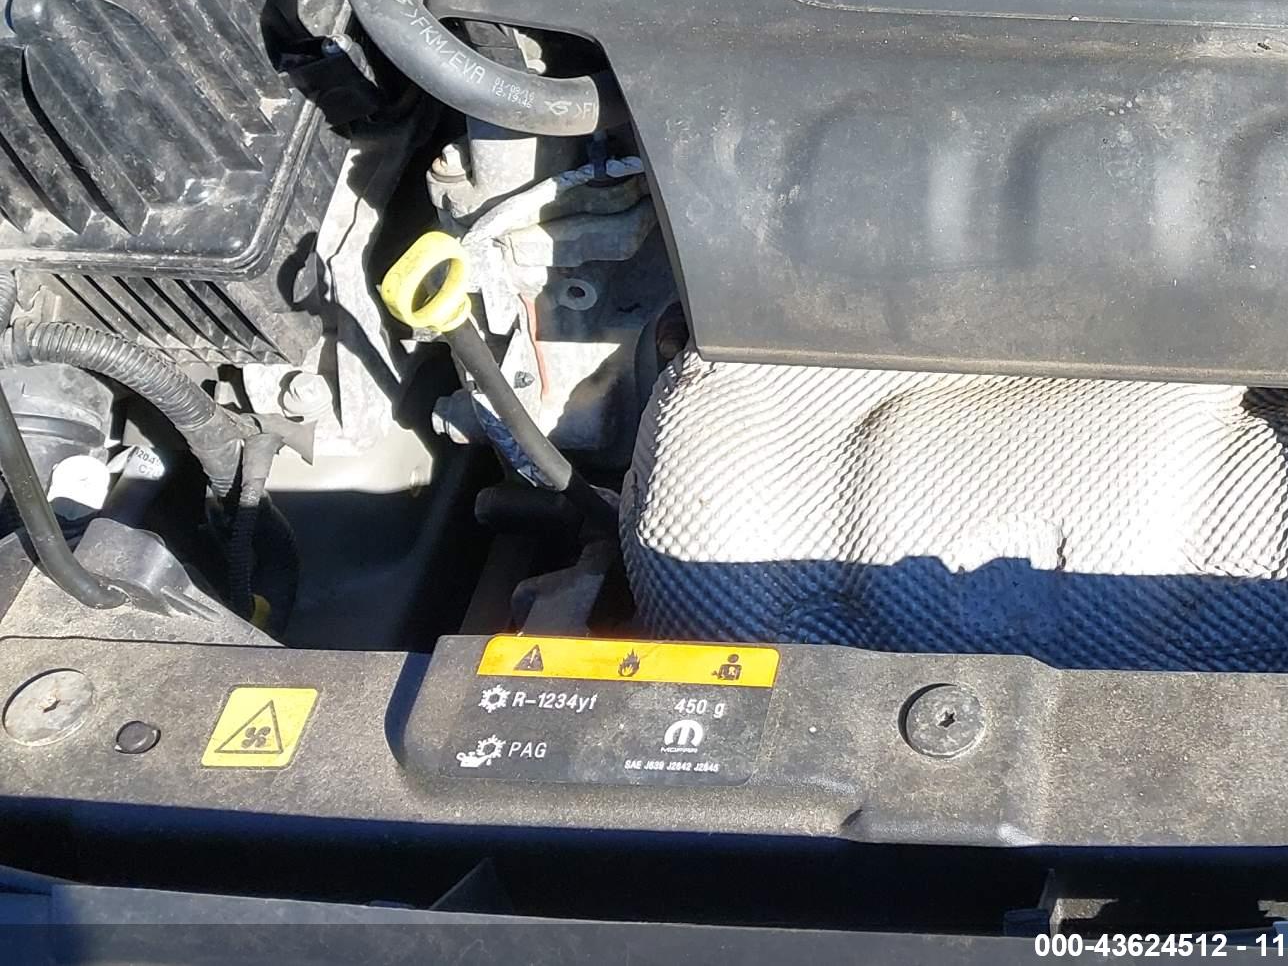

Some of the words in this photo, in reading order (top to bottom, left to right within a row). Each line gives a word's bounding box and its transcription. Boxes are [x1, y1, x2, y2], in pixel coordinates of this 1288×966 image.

[512, 692, 598, 714] R-1234yf
[674, 698, 708, 714] 450
[713, 702, 726, 719] g
[508, 741, 548, 759] PAG
[624, 759, 642, 770] SAE
[644, 760, 665, 771] J639
